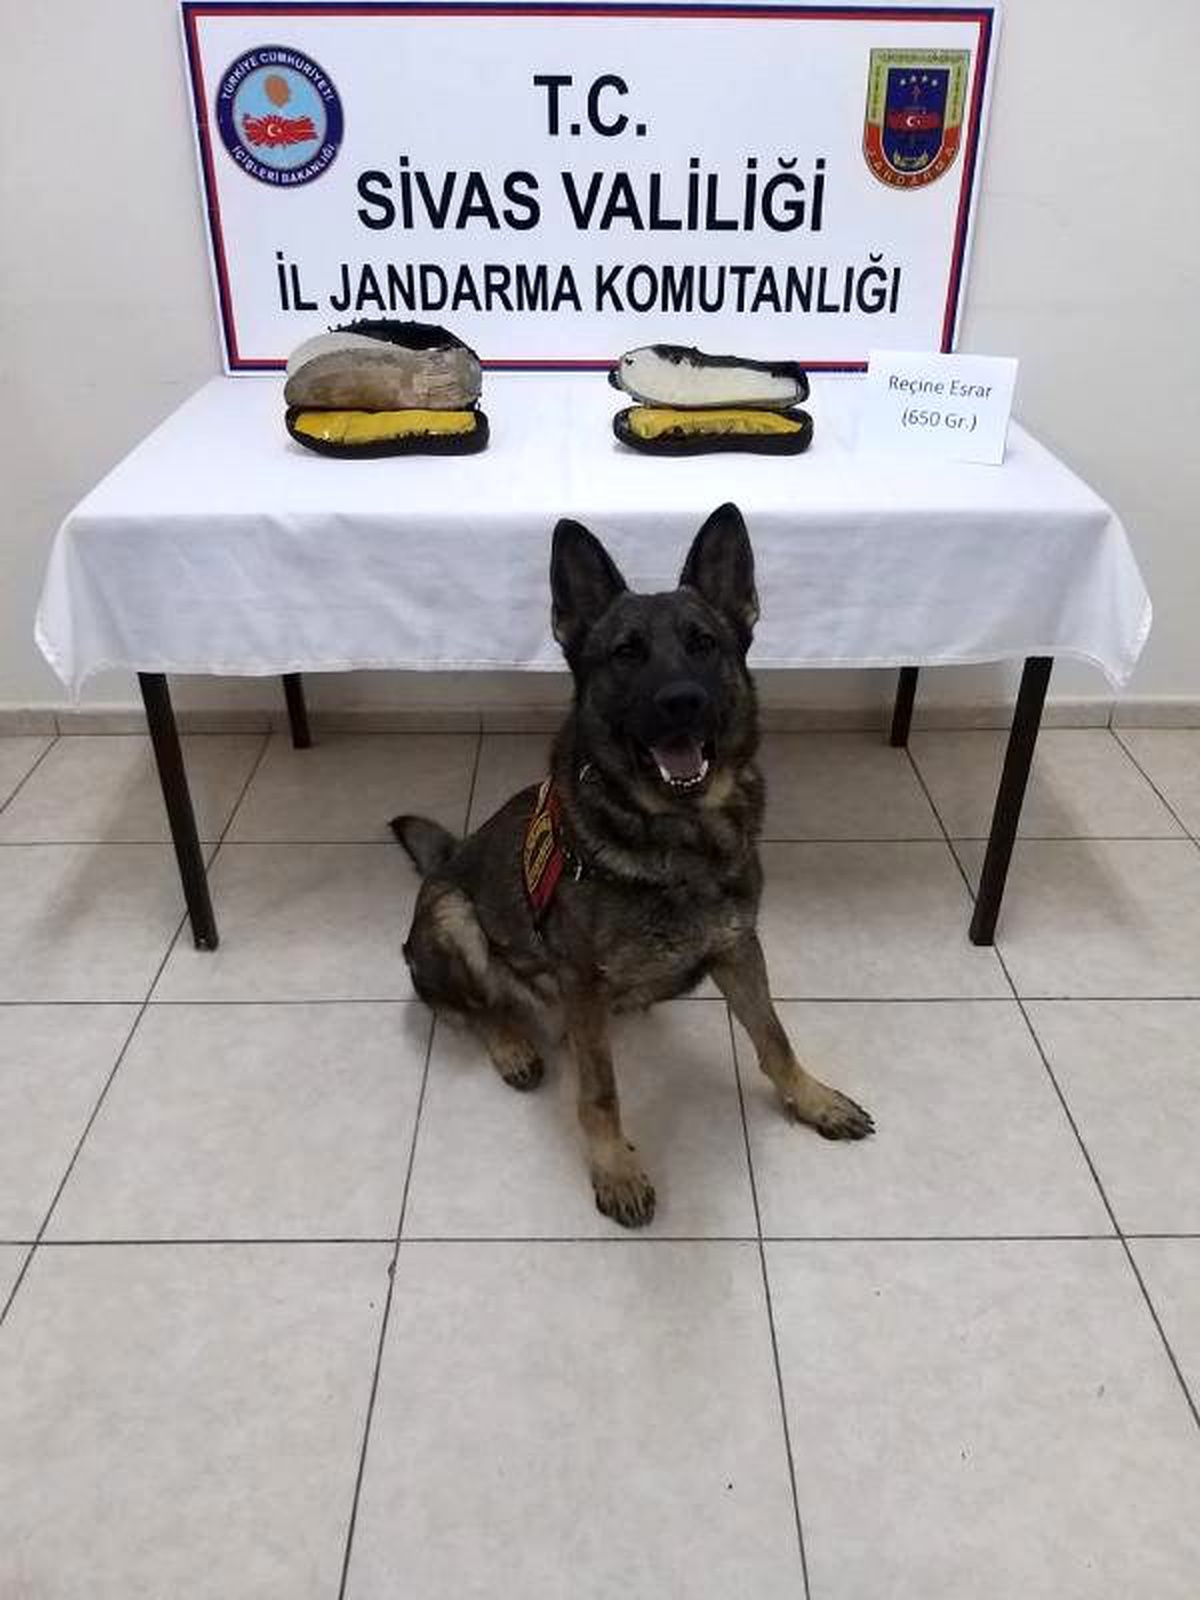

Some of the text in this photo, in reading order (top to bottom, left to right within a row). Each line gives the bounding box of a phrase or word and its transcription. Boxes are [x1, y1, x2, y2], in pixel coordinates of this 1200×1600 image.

[533, 75, 647, 136] T.C.
[357, 155, 826, 232] SİVAS VALİLİĞİ
[276, 251, 901, 314] İL JANDARMA KOMUTANLIĞI
[888, 375, 993, 400] Reçine Esrar
[901, 407, 978, 432] (650 Gr.)
